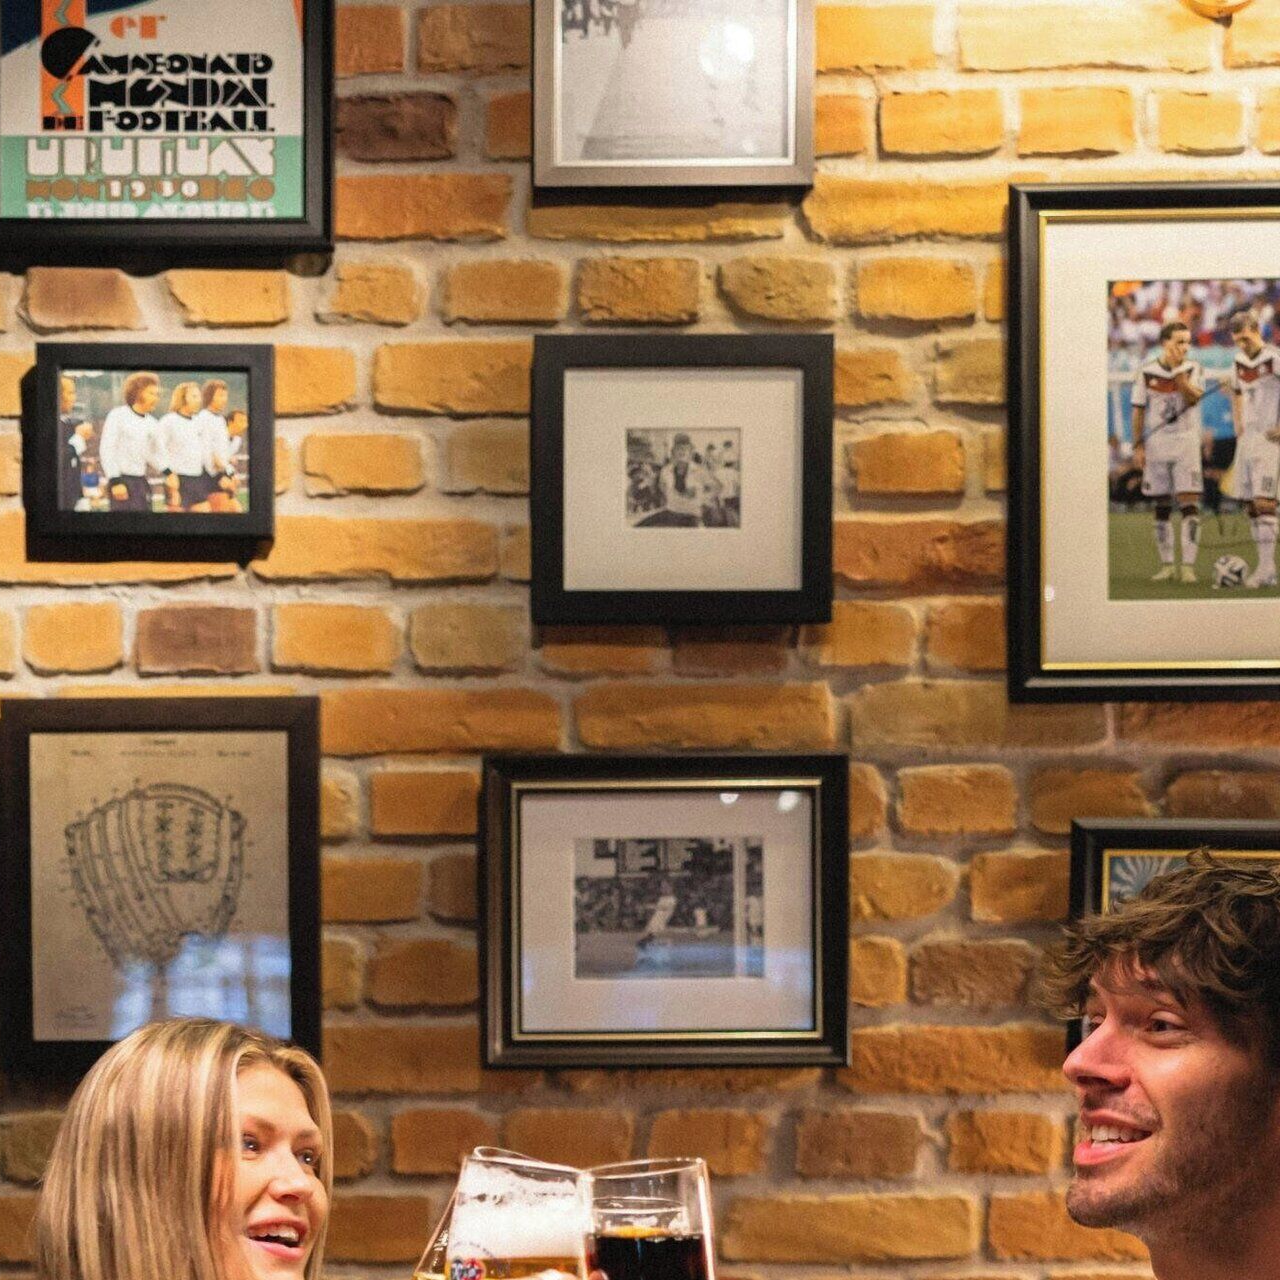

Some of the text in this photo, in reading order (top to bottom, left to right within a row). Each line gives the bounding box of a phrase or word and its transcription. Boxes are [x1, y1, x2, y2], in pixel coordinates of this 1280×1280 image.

[41, 26, 274, 81] CAMPEONATO
[89, 78, 276, 108] MUNDIAL
[89, 110, 276, 132] FOOTBALL
[25, 137, 276, 176] URUGUAY
